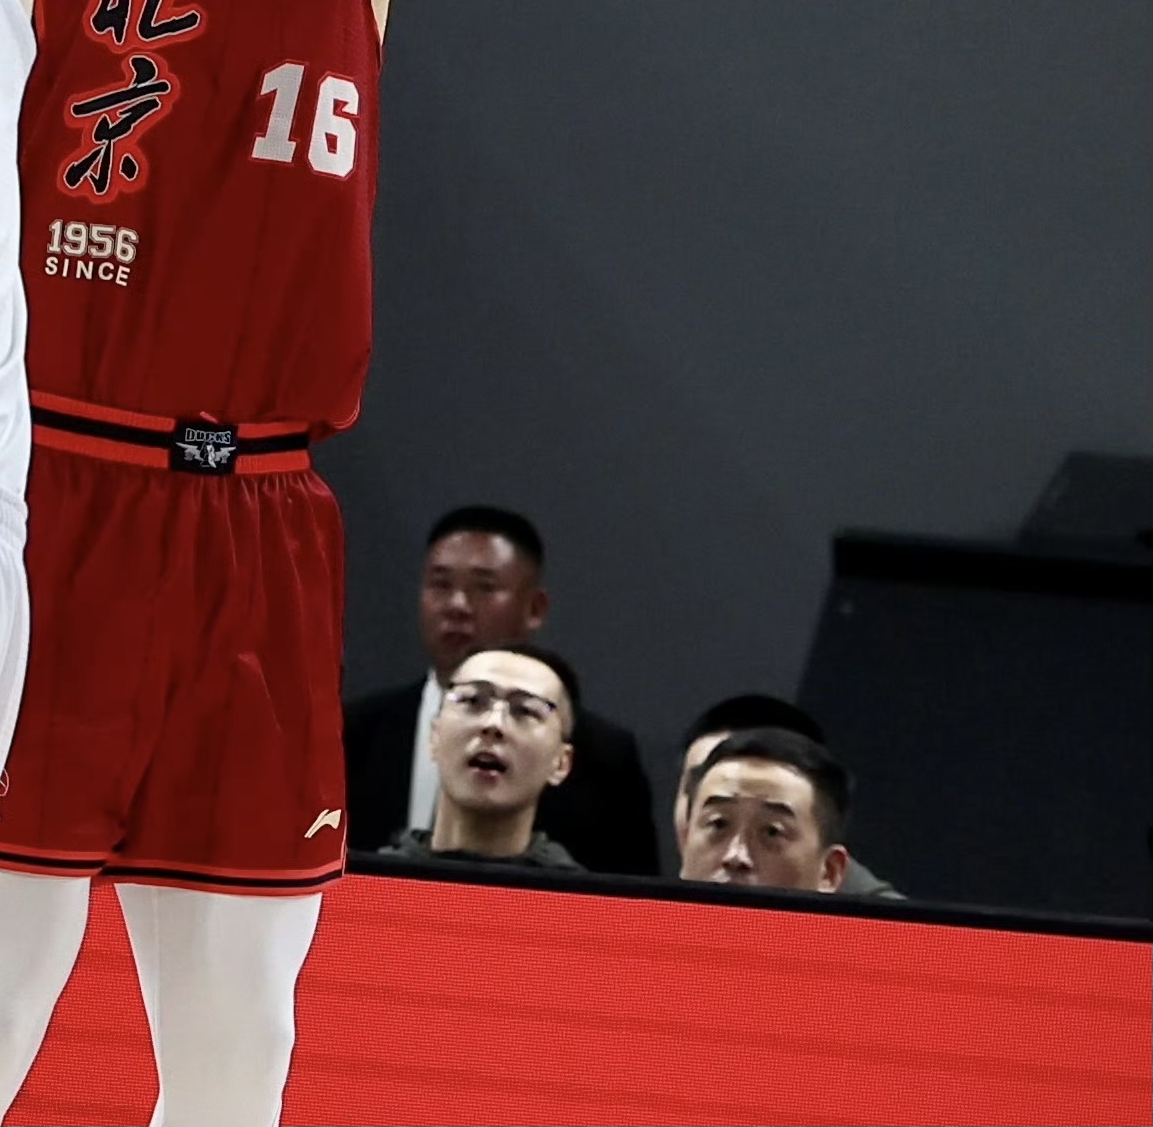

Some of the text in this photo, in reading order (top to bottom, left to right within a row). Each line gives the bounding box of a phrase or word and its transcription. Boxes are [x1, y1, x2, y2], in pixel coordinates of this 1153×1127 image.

[251, 62, 360, 177] 16
[47, 218, 139, 264] 1956
[44, 256, 131, 287] SINCE
